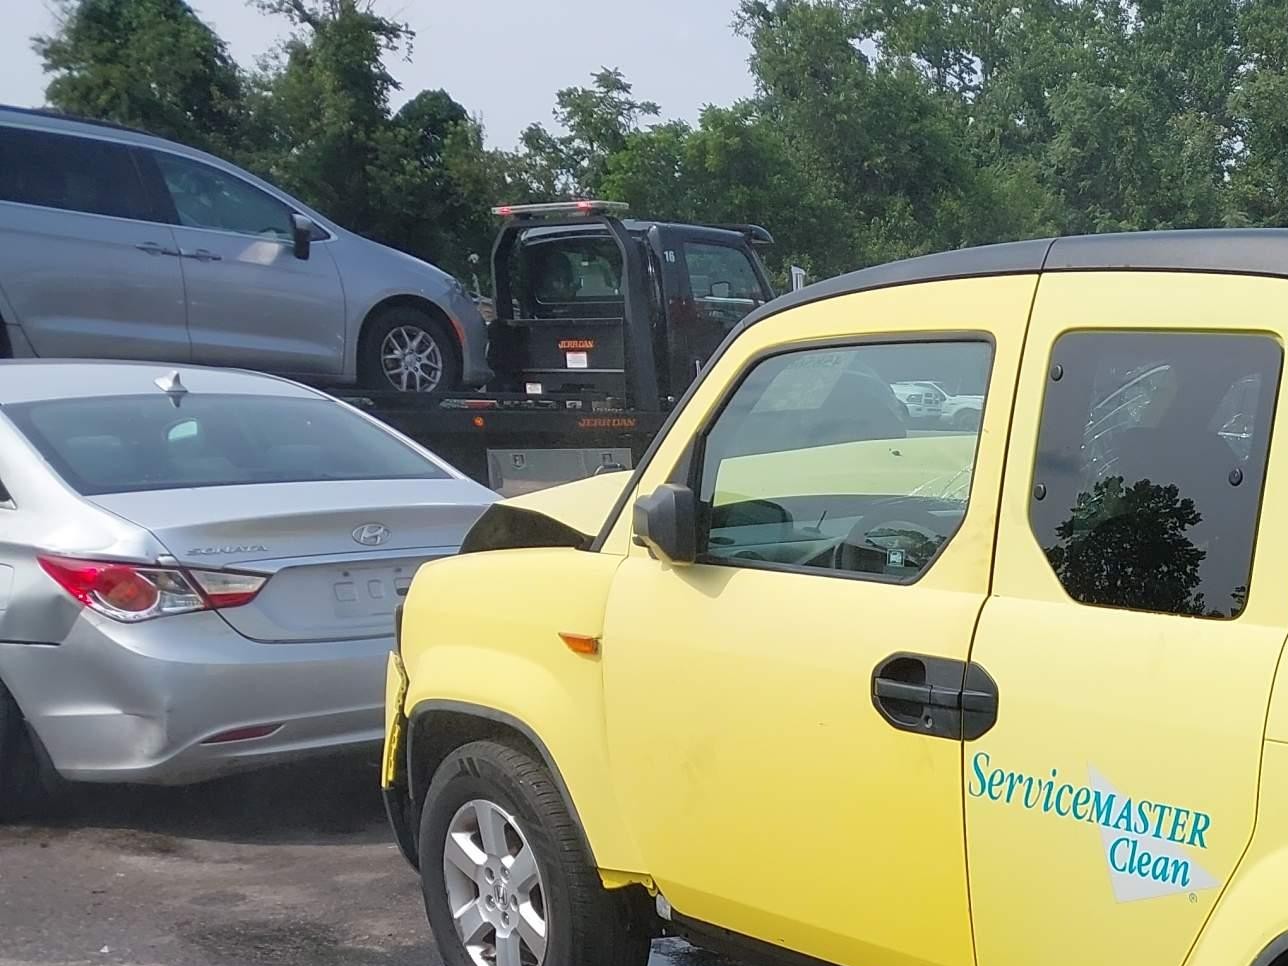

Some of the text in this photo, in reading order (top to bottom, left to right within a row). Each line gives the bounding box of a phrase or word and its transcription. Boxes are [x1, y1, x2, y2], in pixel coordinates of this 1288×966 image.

[664, 250, 675, 262] 16
[185, 544, 271, 556] SONATA
[968, 752, 1211, 848] ServiceMASTER
[1109, 837, 1190, 887] Clean
